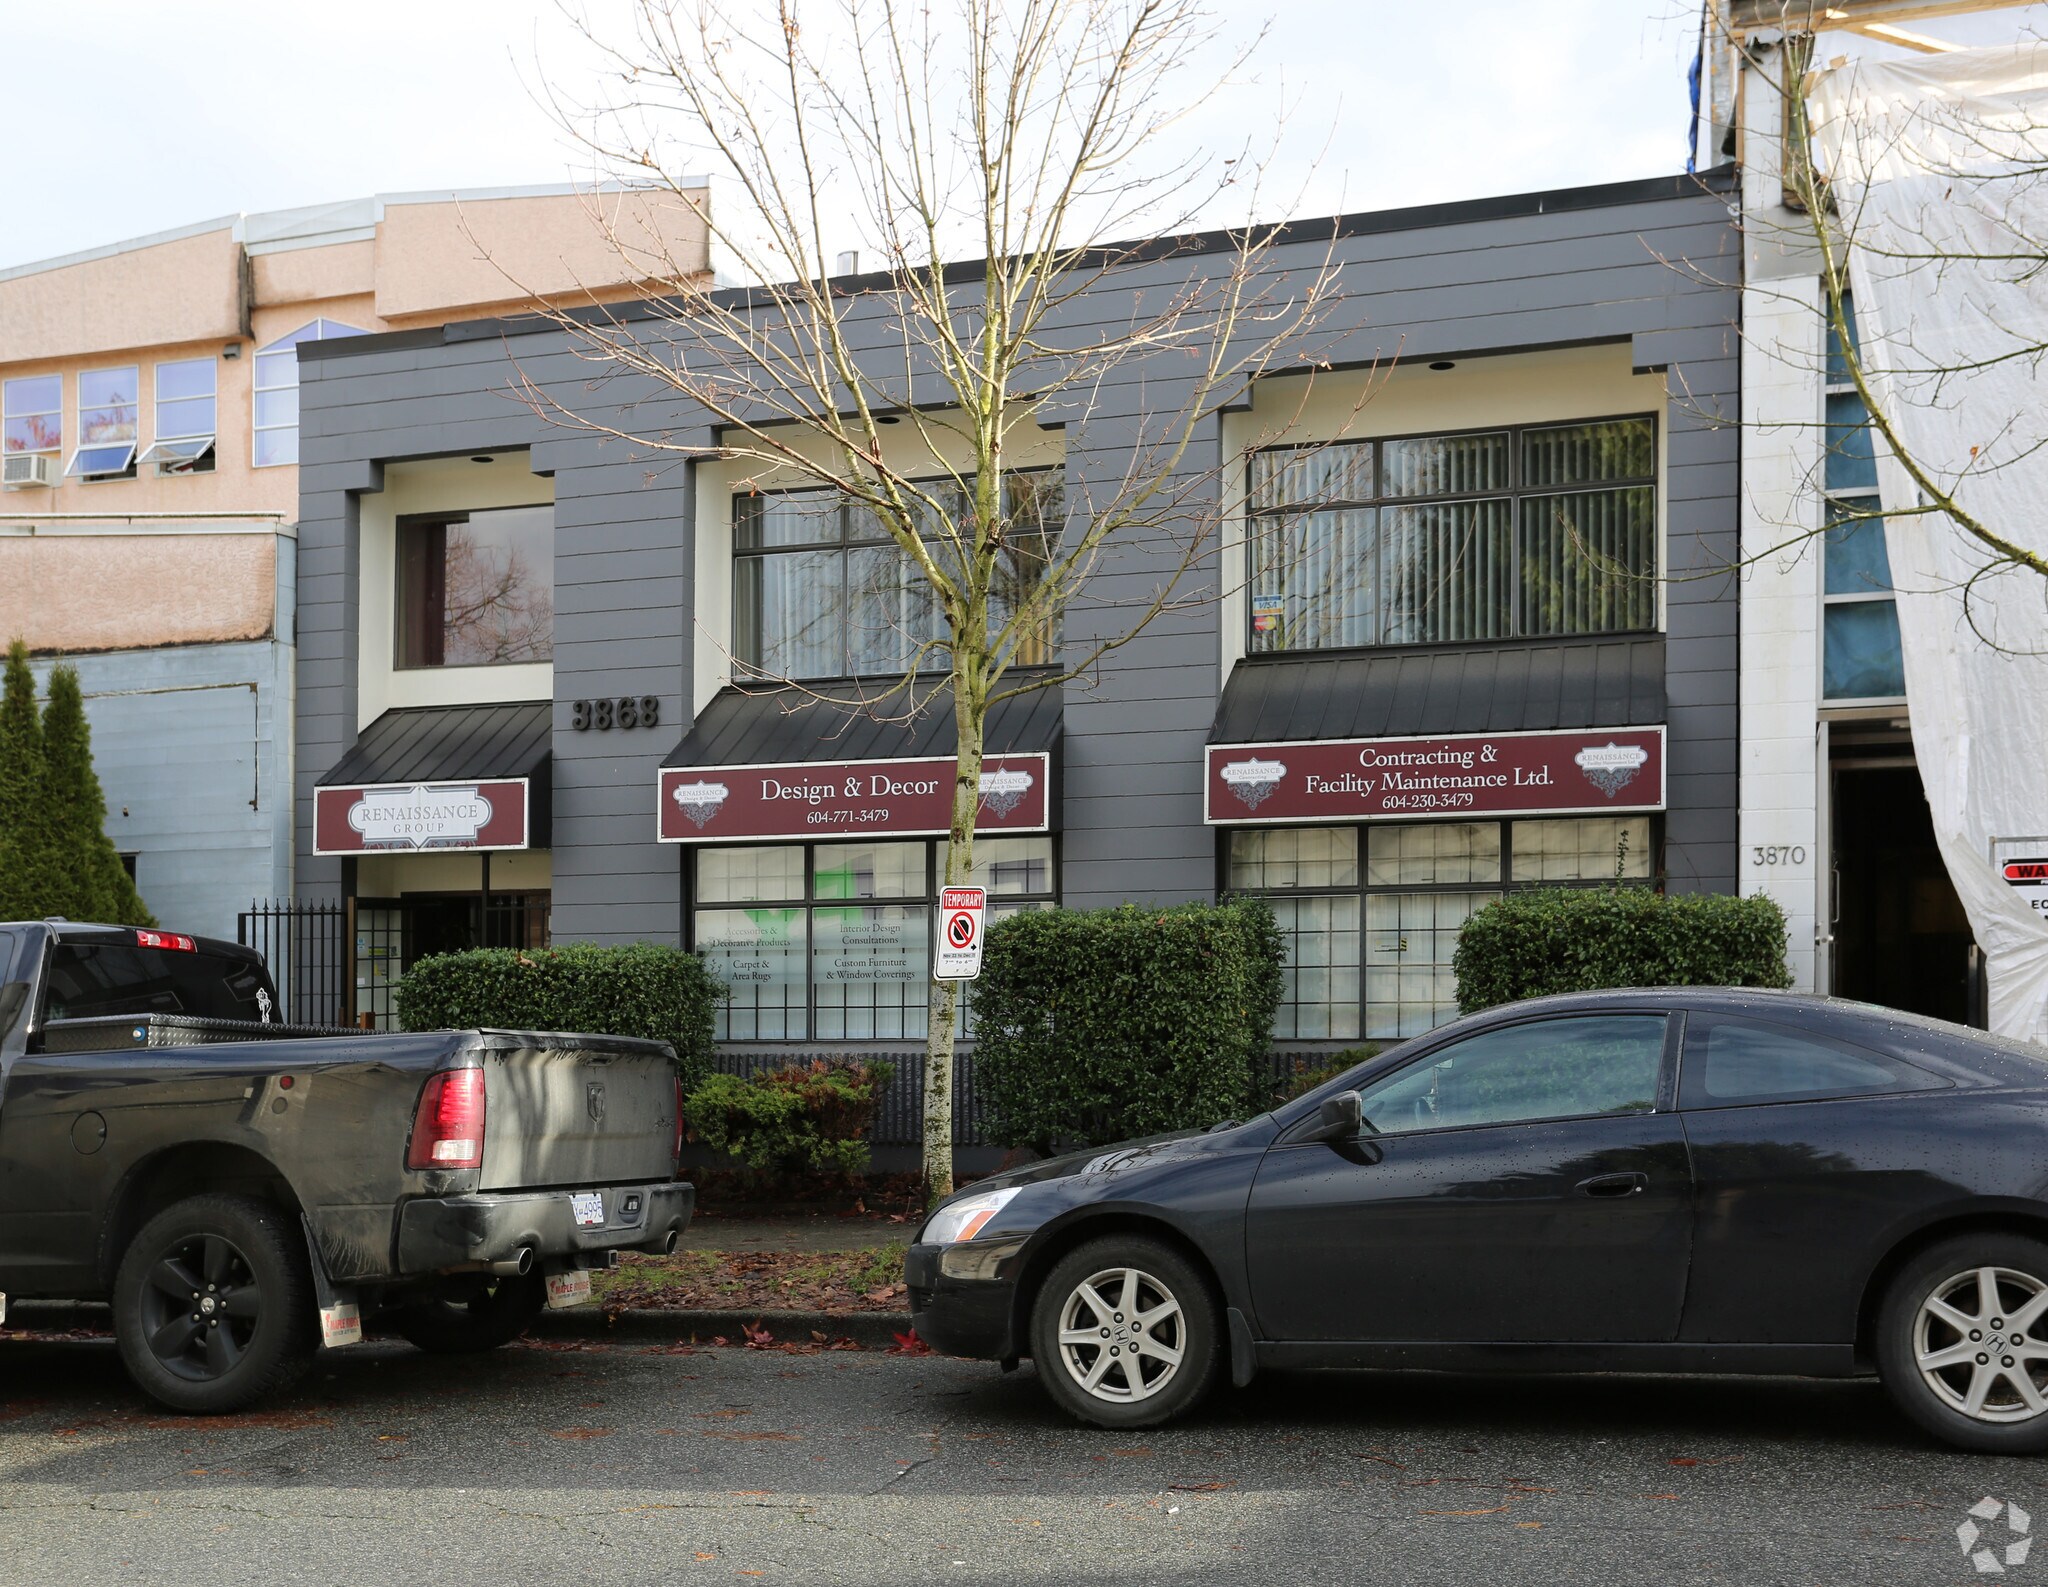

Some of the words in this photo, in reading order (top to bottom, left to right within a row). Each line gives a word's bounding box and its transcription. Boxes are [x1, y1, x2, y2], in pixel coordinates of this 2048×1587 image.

[1259, 601, 1278, 609] VISA
[572, 695, 659, 731] 3868
[1360, 745, 1475, 769] Contracting
[1480, 744, 1498, 763] &
[1582, 752, 1640, 761] RENAISSANCE
[1305, 773, 1376, 797] Facility
[1380, 771, 1508, 791] Maintenance
[1513, 765, 1554, 786] Ltd.
[760, 777, 836, 805] Design
[843, 776, 863, 797] &
[869, 774, 939, 797] Decor
[1382, 793, 1473, 809] 604-230-3479
[361, 804, 478, 821] RENAISSANCE
[806, 808, 889, 824] 604-771-3479
[393, 823, 444, 833] GROUP
[1753, 846, 1806, 866] 3870
[944, 893, 983, 907] TEMPORARY
[769, 927, 778, 935] &
[840, 924, 870, 932] Interior
[872, 923, 901, 934] Design
[712, 939, 755, 947] Decorative
[756, 938, 791, 947] Products
[842, 935, 899, 945] Consultations
[733, 960, 760, 970] Carpet
[761, 960, 770, 968] &
[834, 959, 867, 968] Custom
[868, 957, 907, 967] Furniture
[732, 972, 750, 980] Area
[752, 972, 771, 982] Rugs
[826, 971, 834, 979] &
[836, 970, 872, 979] Window
[873, 969, 916, 980] Coverings
[556, 1283, 574, 1294] MAPLE
